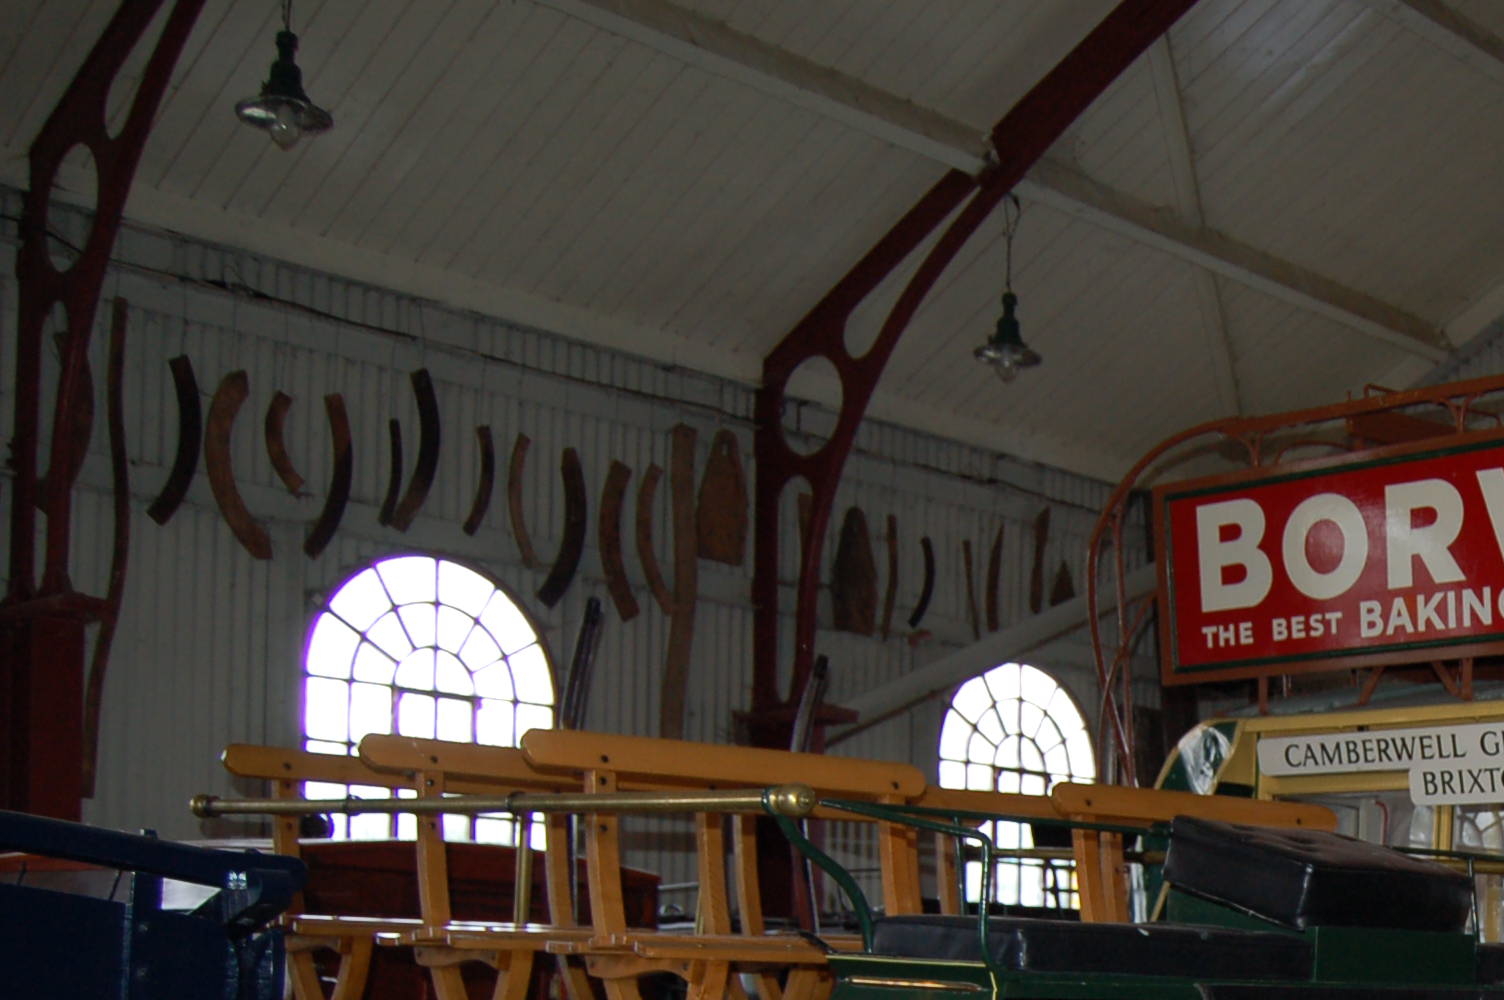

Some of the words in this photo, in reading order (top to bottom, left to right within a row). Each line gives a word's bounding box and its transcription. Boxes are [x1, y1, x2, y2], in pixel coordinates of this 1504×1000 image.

[1202, 616, 1256, 650] THE
[1271, 611, 1343, 642] BEST
[1284, 732, 1467, 769] CAMBERWELL
